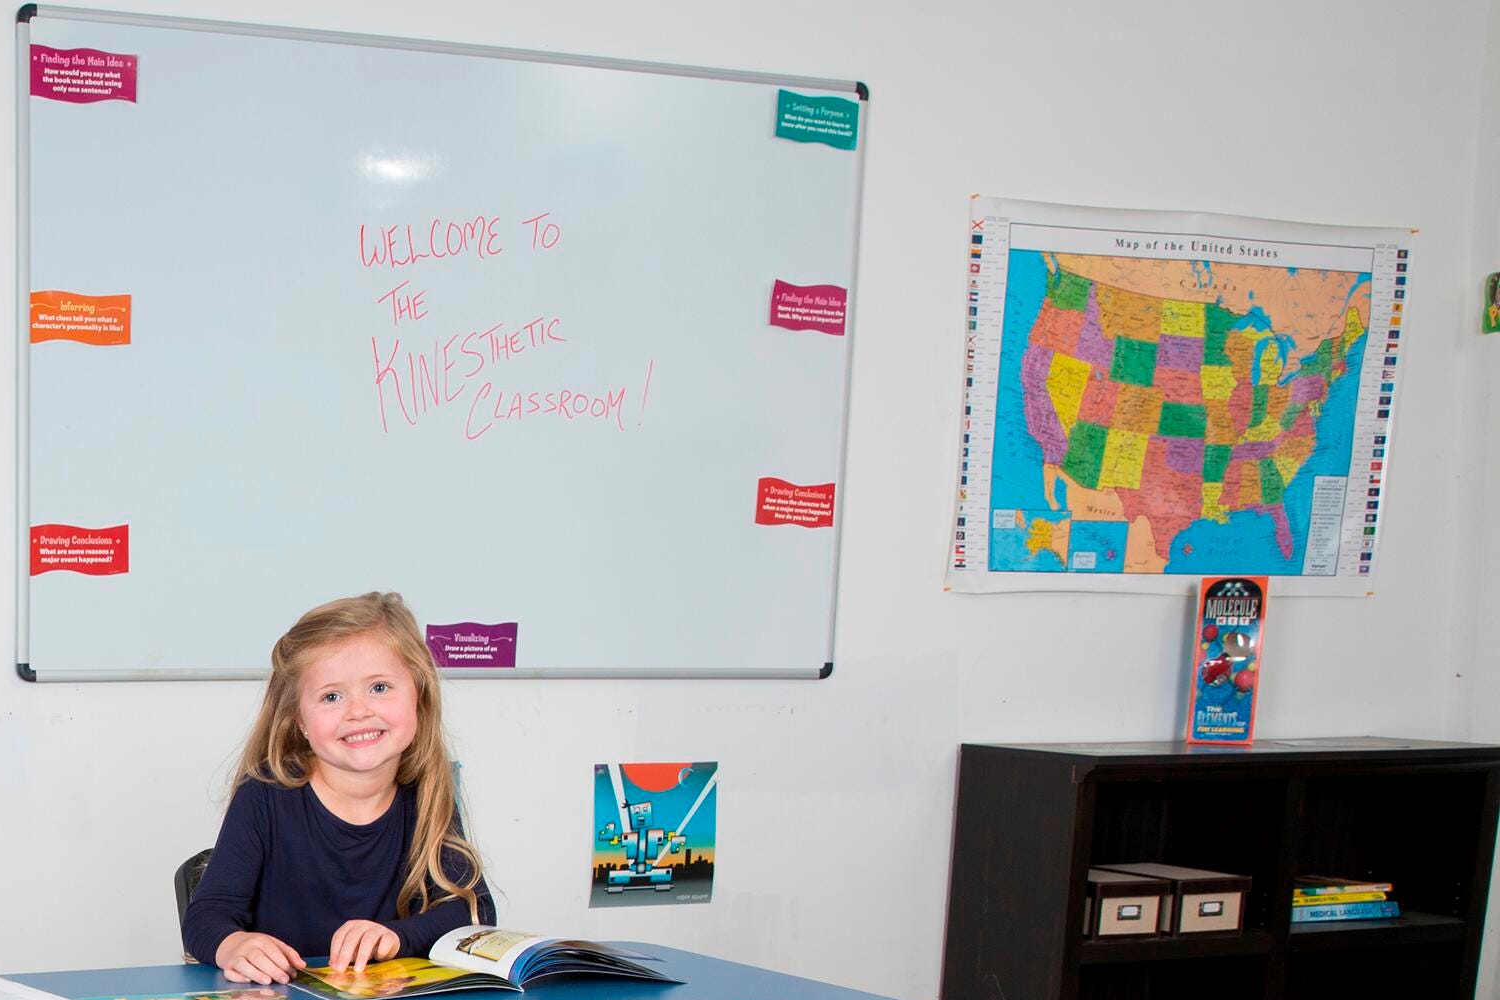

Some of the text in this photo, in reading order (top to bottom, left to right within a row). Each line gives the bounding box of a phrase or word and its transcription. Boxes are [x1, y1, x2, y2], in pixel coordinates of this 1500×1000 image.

[40, 53, 125, 68] Finding the Main Idea
[359, 212, 560, 268] WELCOME TO
[1115, 238, 1278, 258] Map of the United States
[1179, 279, 1237, 291] Canada
[378, 280, 428, 326] THE
[372, 317, 567, 433] KINESTHETIC
[1086, 505, 1117, 517] Mexico
[40, 535, 113, 548] Drawing Conclusions
[1206, 598, 1258, 619] MOLECULE
[1217, 617, 1250, 625] KIT
[1310, 909, 1338, 918] MEDICAL
